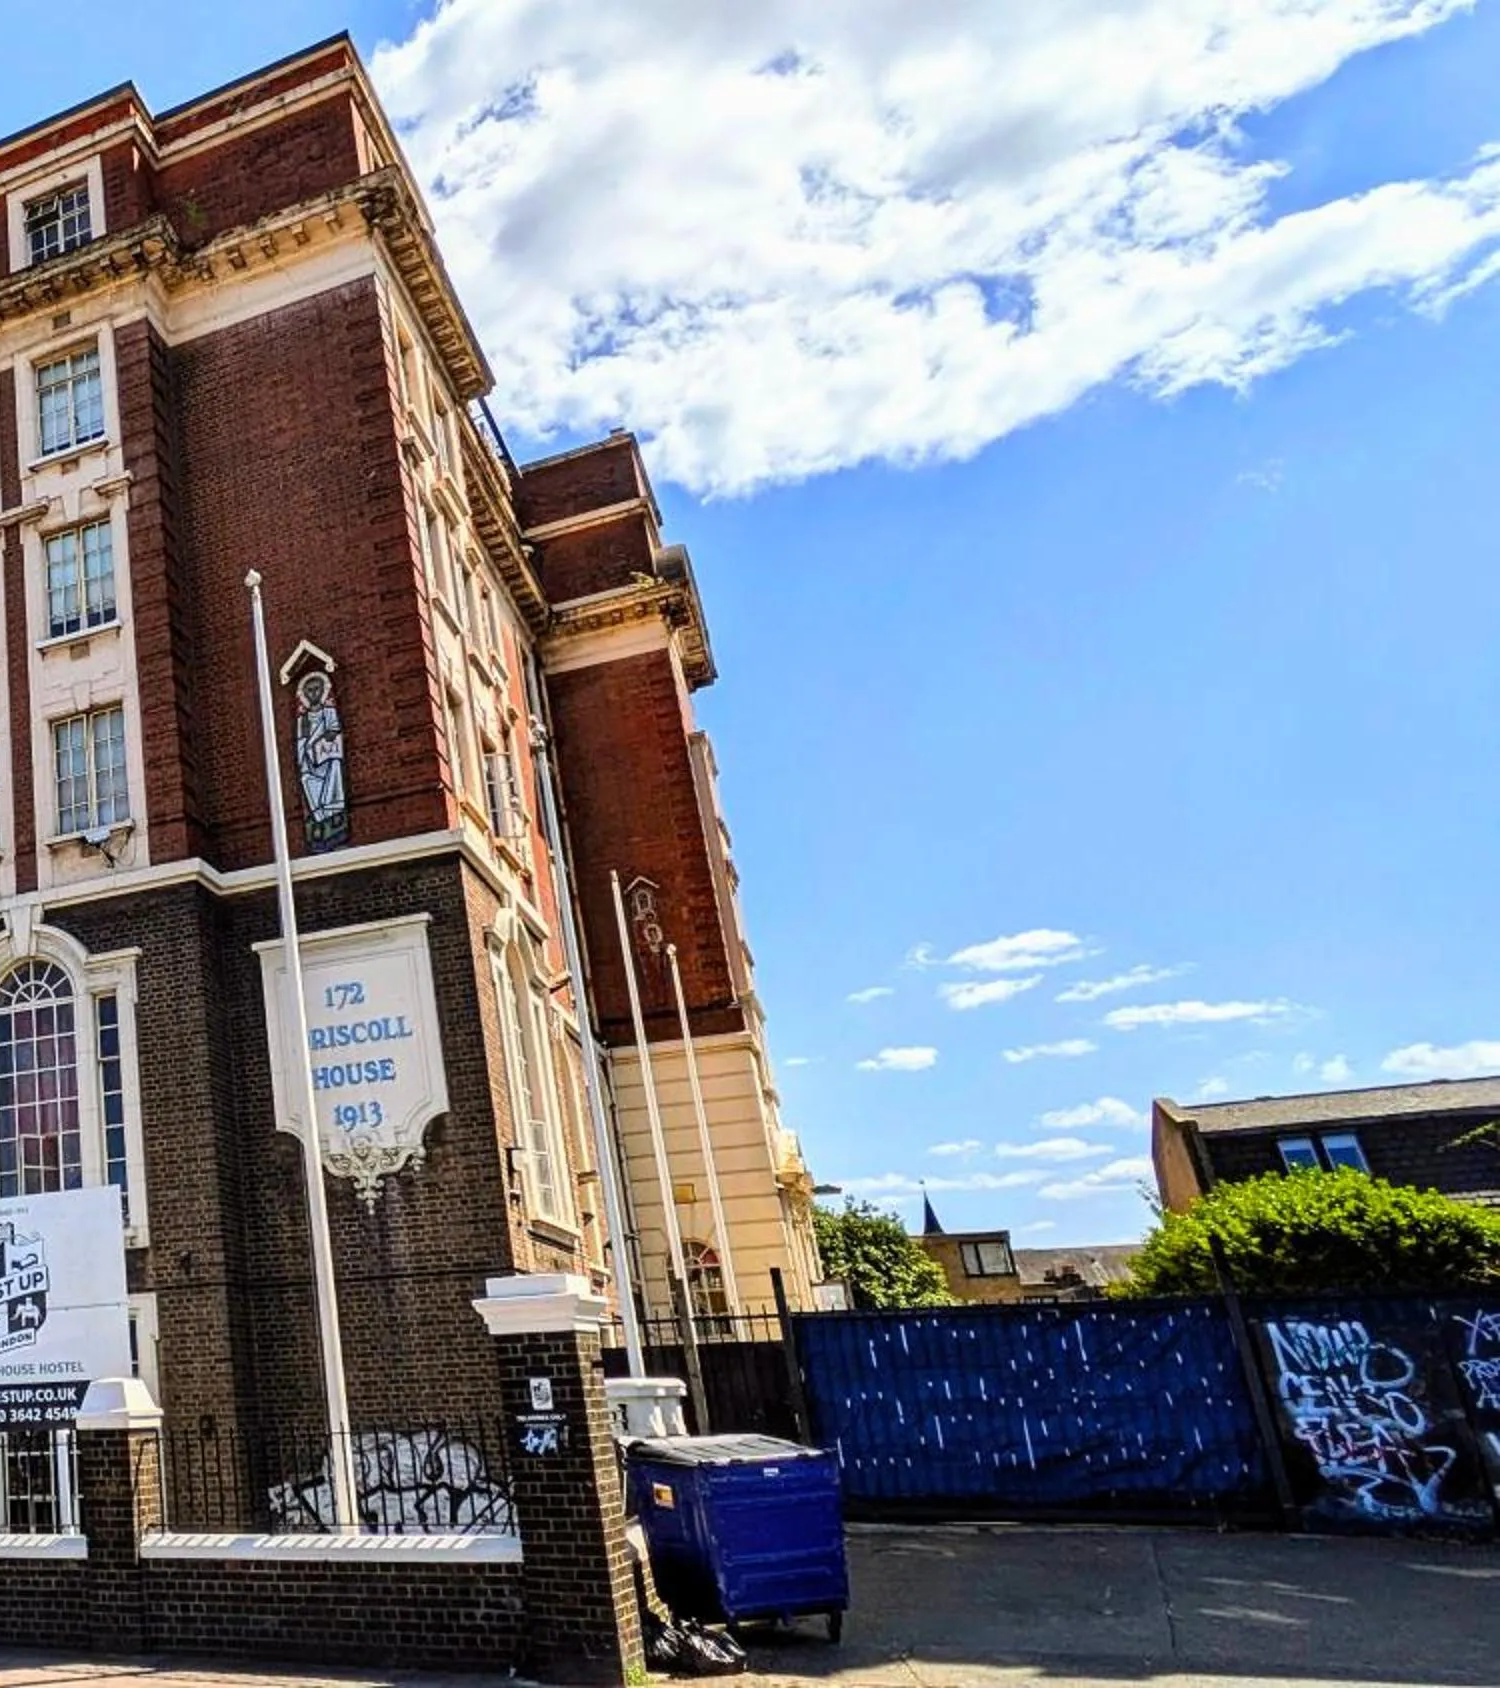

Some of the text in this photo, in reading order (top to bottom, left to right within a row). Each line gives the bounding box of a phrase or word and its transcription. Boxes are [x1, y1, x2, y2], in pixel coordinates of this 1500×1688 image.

[324, 981, 365, 1010] 172
[307, 1015, 413, 1050] RISCOLL
[311, 1057, 397, 1090] HOUSE
[334, 1100, 384, 1133] 1913
[19, 1271, 45, 1291] UP
[39, 1360, 85, 1375] HOSTEL
[9, 1408, 42, 1422] 3642
[45, 1407, 77, 1421] 4549
